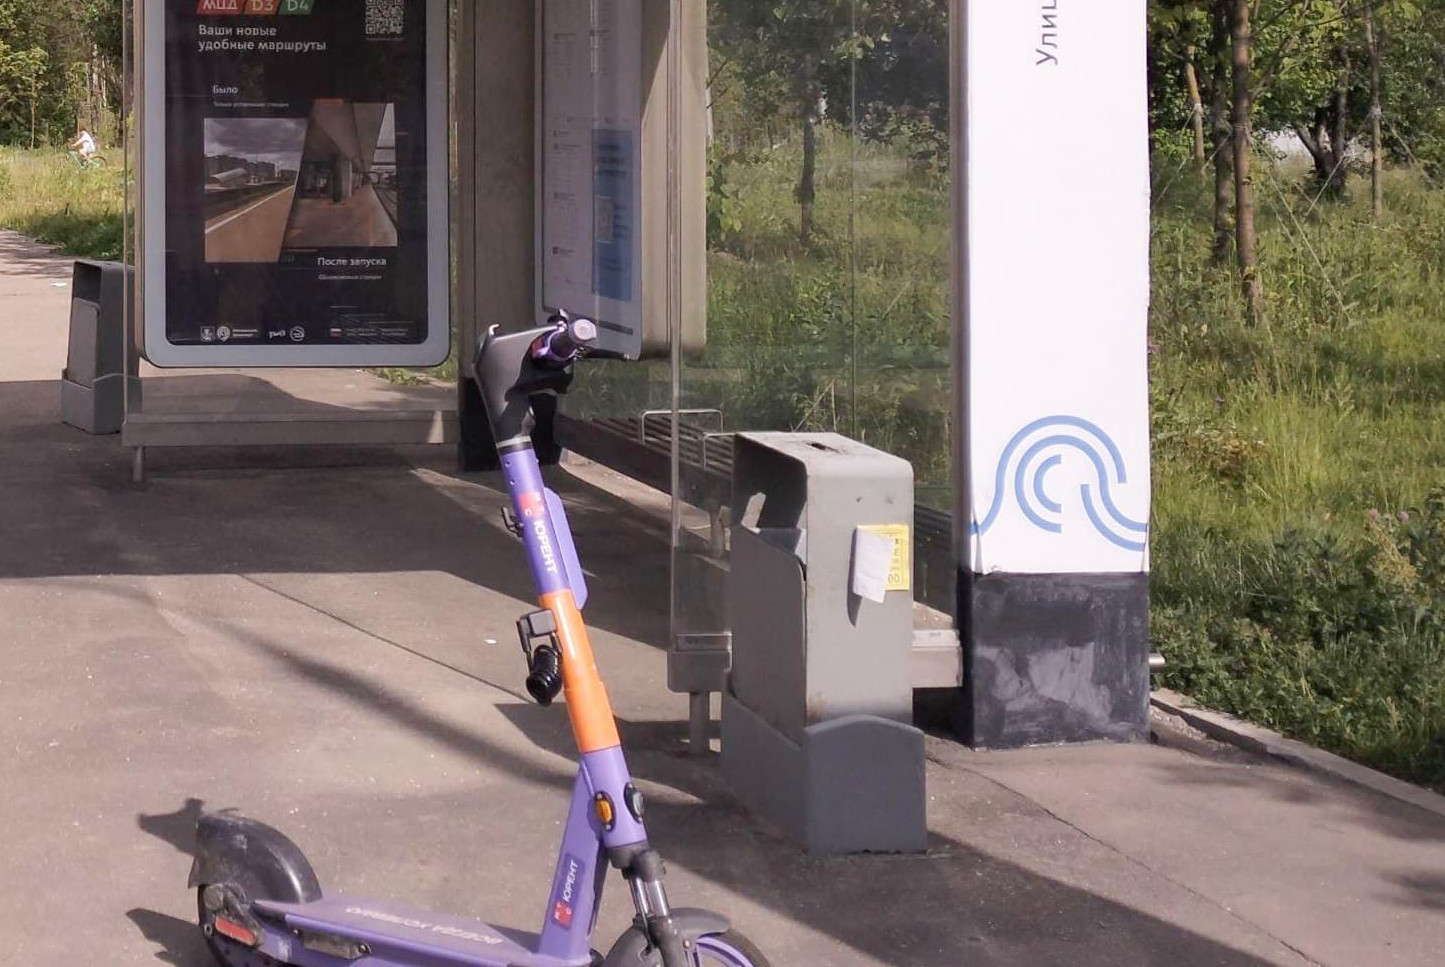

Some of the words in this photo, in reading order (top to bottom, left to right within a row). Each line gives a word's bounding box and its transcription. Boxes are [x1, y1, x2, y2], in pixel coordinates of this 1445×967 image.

[198, 24, 233, 36] Ваши
[236, 26, 277, 36] новые
[198, 38, 255, 52] удобные
[258, 41, 327, 52] маршруты
[213, 85, 238, 94] Было
[317, 257, 347, 265] После
[349, 258, 387, 267] запуска
[534, 520, 558, 574] ЮРЕНТ
[562, 859, 578, 903] ЮРЕНТ
